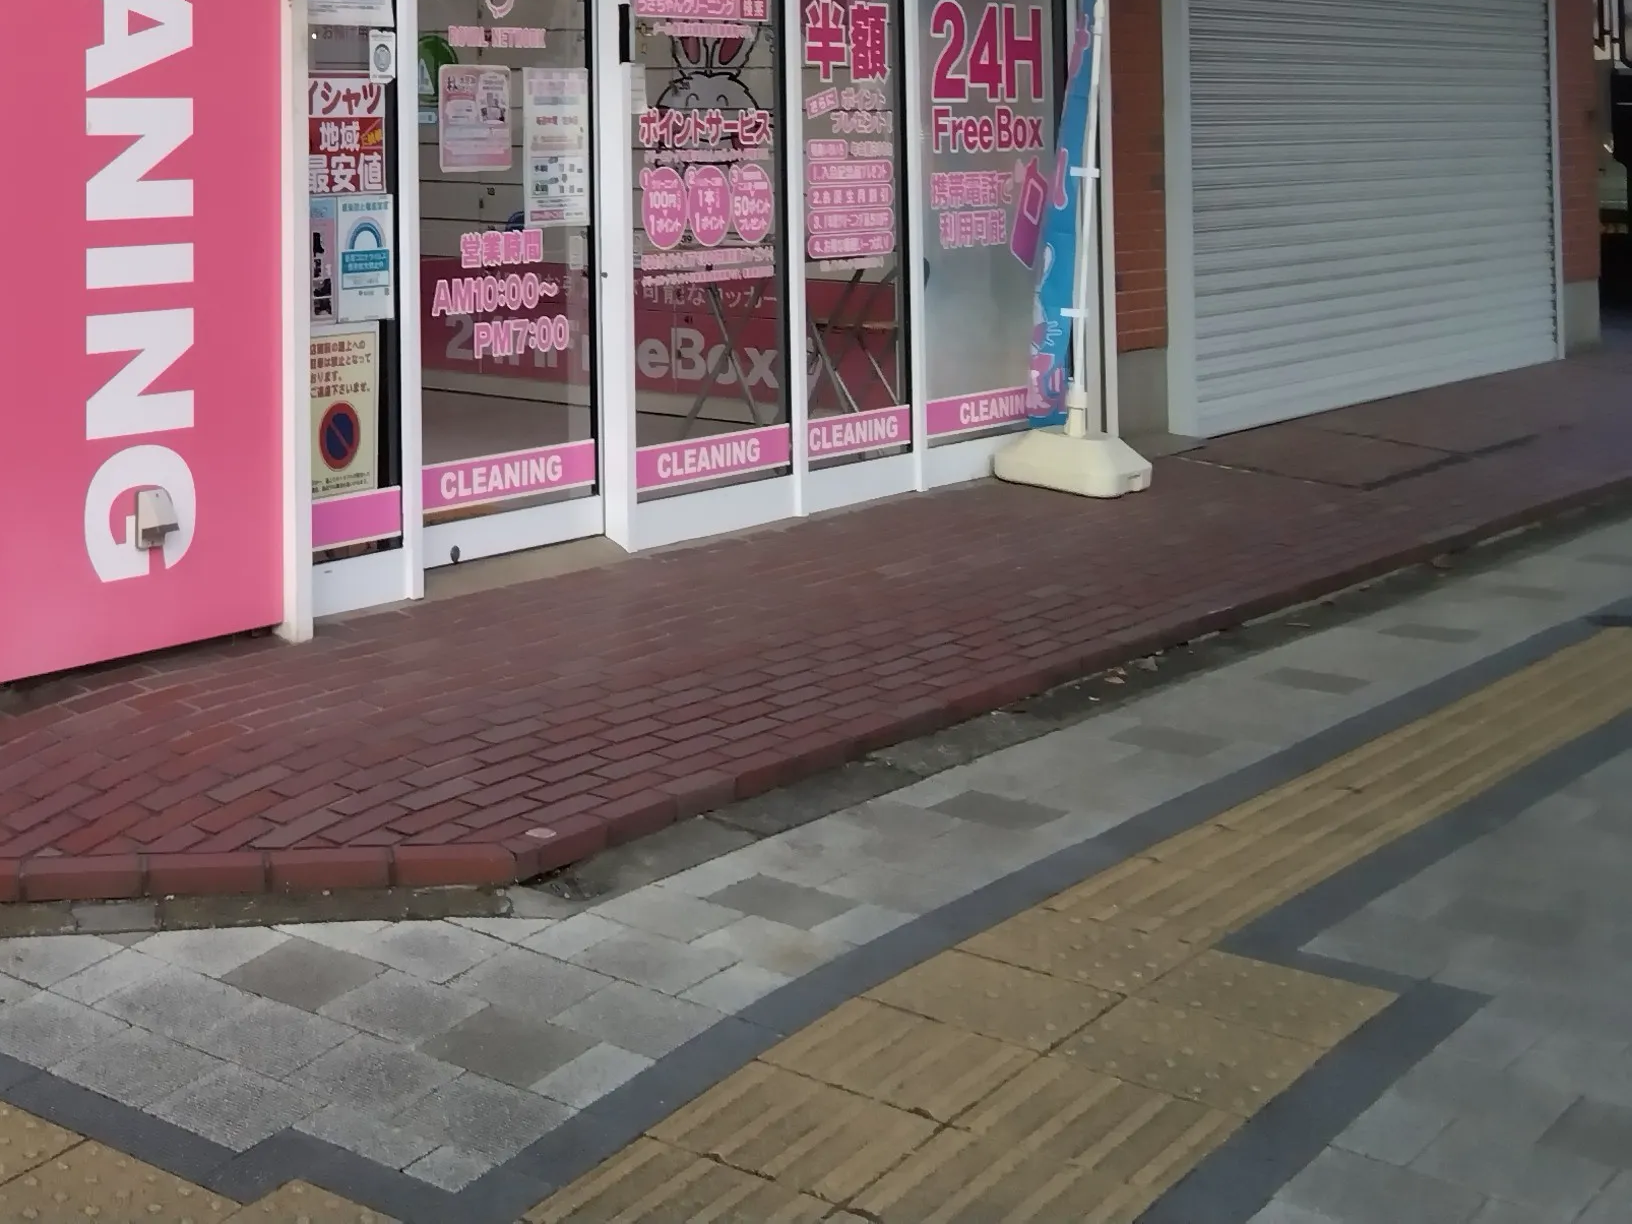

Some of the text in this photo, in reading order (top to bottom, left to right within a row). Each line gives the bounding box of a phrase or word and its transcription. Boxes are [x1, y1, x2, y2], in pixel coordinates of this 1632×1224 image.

[319, 121, 361, 151] 地域
[639, 107, 773, 148] ポイントサービス
[309, 152, 384, 194] 最安値
[459, 228, 544, 269] 営業時間
[473, 314, 569, 360] PM7:00
[959, 392, 1028, 426] CLEANIN
[808, 414, 899, 452] CLEANING
[439, 454, 563, 501] CLEANING
[656, 437, 761, 478] CLEANING
